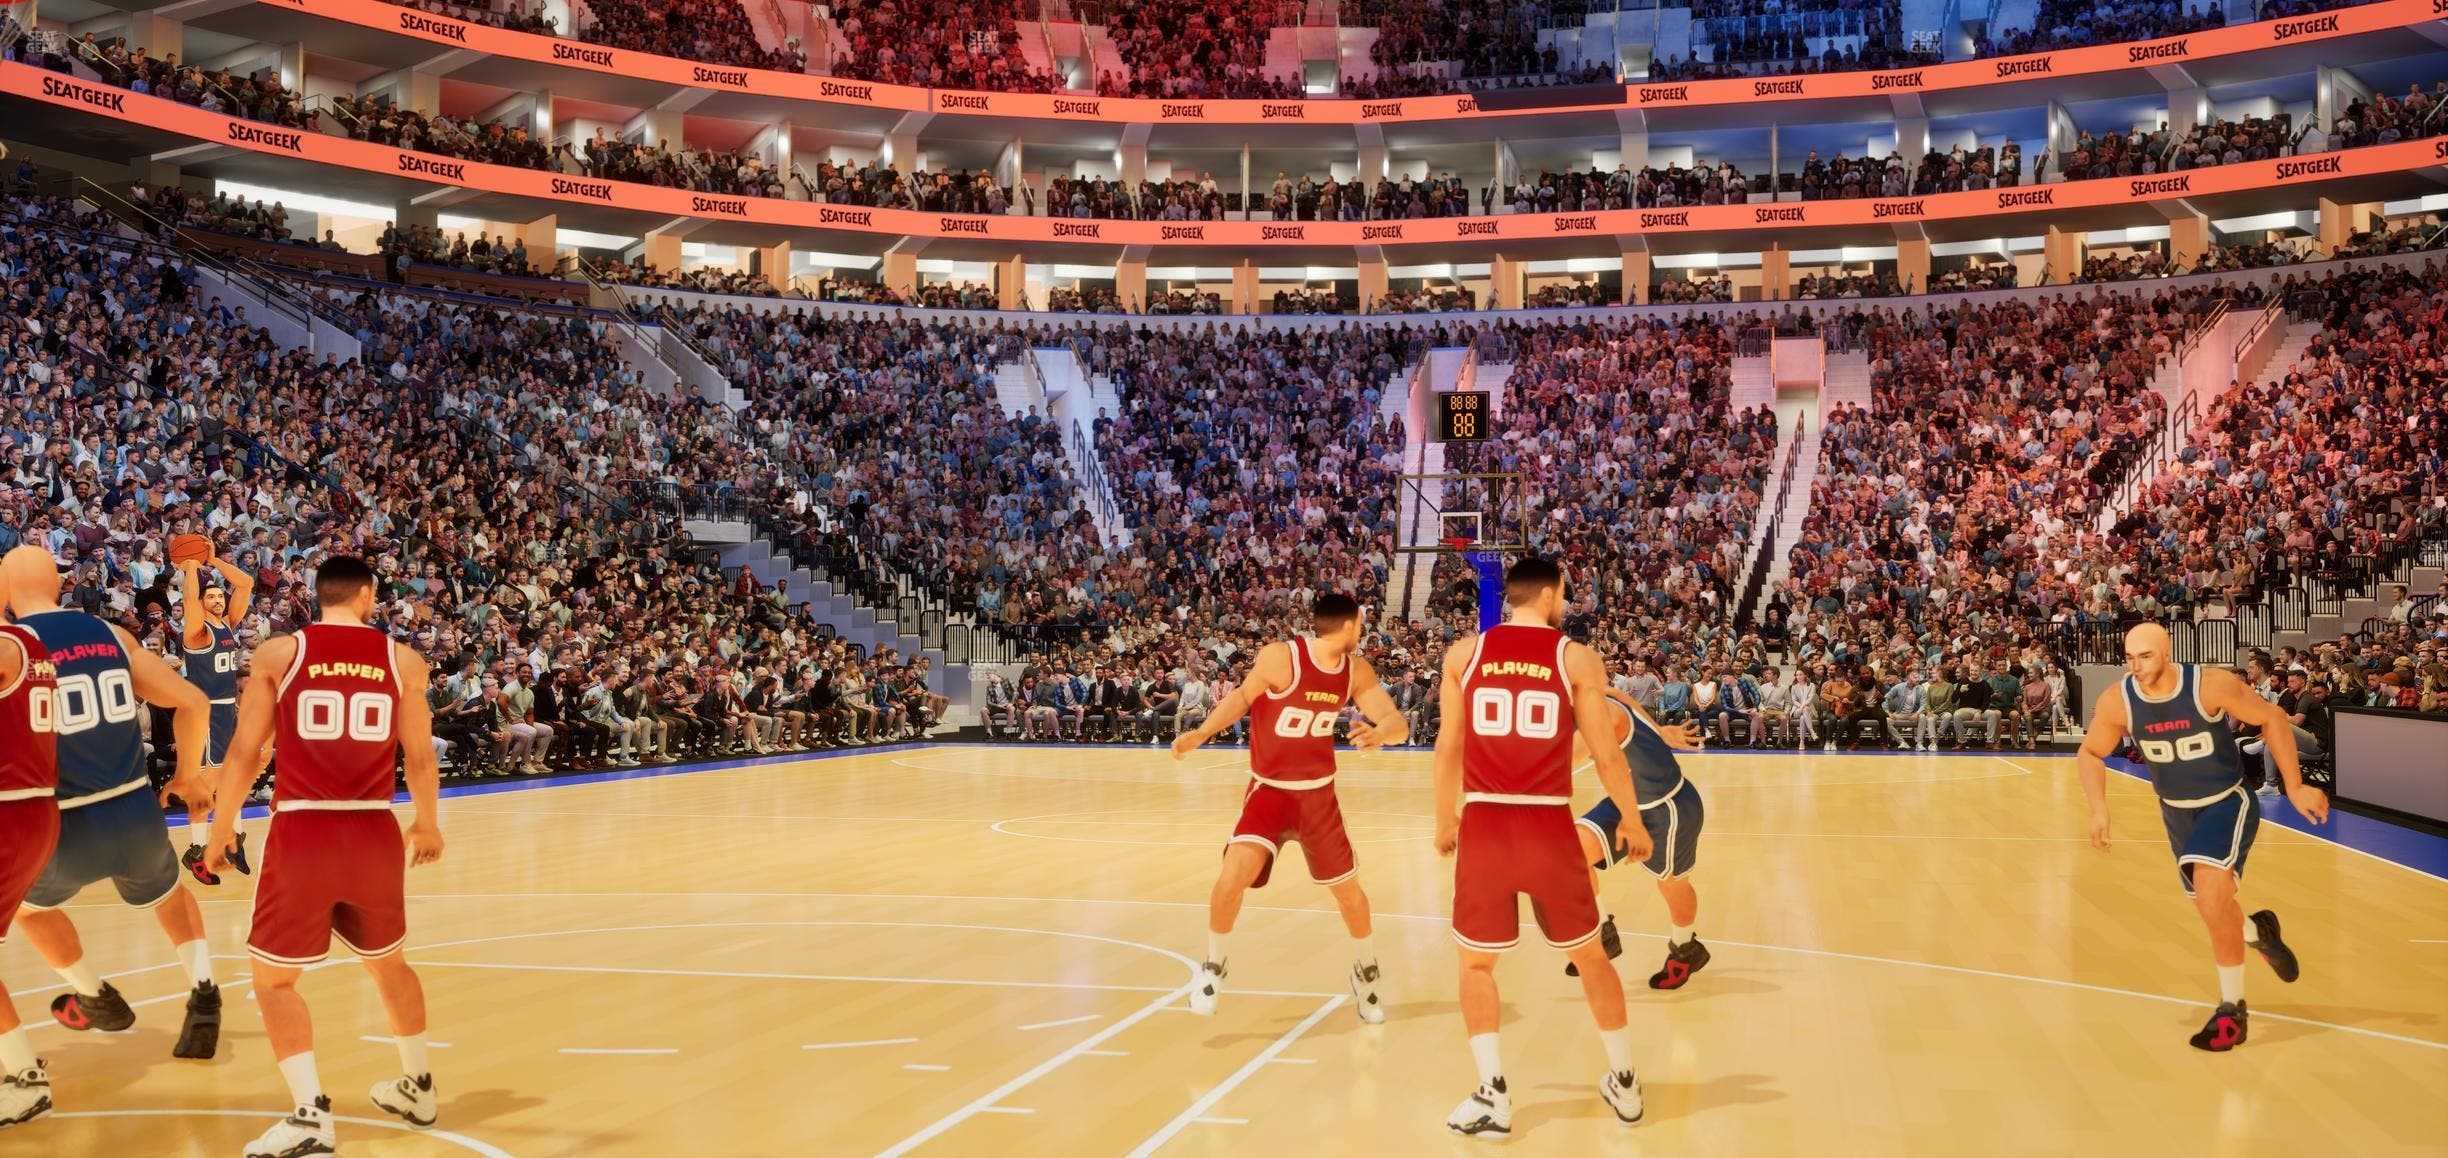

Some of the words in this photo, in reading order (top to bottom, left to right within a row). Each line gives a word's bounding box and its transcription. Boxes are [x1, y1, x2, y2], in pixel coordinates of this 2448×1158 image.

[399, 11, 467, 43] SEATGEEK
[2273, 14, 2340, 41] SEATGEEK
[552, 42, 614, 68] SEATGEEK
[2128, 38, 2189, 63] SEATGEEK
[693, 66, 748, 88] SEATGEEK
[1996, 55, 2052, 78] SEATGEEK
[1754, 78, 1804, 97] SEATGEEK
[1871, 70, 1924, 91] SEATGEEK
[42, 75, 125, 114] SEATGEEK
[820, 81, 873, 102] SEATGEEK
[940, 93, 989, 111] SEATGEEK
[1639, 85, 1688, 104] SEATGEEK
[1053, 99, 1100, 116] SEATGEEK
[1161, 103, 1204, 119] SEATGEEK
[1261, 104, 1305, 119] SEATGEEK
[1362, 102, 1402, 119] SEATGEEK
[228, 121, 302, 153] SEATGEEK
[398, 153, 465, 182] SEATGEEK
[2276, 154, 2342, 180] SEATGEEK
[551, 177, 612, 201] SEATGEEK
[2130, 174, 2191, 198] SEATGEEK
[692, 196, 747, 217] SEATGEEK
[1872, 199, 1925, 219] SEATGEEK
[1998, 188, 2054, 209] SEATGEEK
[820, 207, 872, 227] SEATGEEK
[940, 217, 989, 234] SEATGEEK
[1554, 215, 1597, 232] SEATGEEK
[1640, 211, 1689, 229] SEATGEEK
[1755, 206, 1805, 224] SEATGEEK
[1053, 222, 1100, 239] SEATGEEK
[1161, 225, 1204, 241] SEATGEEK
[1261, 225, 1305, 241] SEATGEEK
[1362, 224, 1403, 241] SEATGEEK
[1457, 220, 1499, 237] SEATGEEK
[1451, 396, 1462, 409] 88
[1466, 396, 1477, 409] 88
[1454, 413, 1474, 437] 88
[51, 643, 118, 666] PLAYER
[307, 662, 386, 683] PLAYER
[1481, 661, 1552, 681] PLAYER
[57, 668, 136, 735] 00
[1304, 691, 1340, 704] TEAM
[297, 689, 393, 742] 00
[1274, 706, 1339, 738] 00
[1472, 687, 1560, 739] 00
[2144, 719, 2191, 734] TEAM
[2139, 731, 2215, 763] 00
